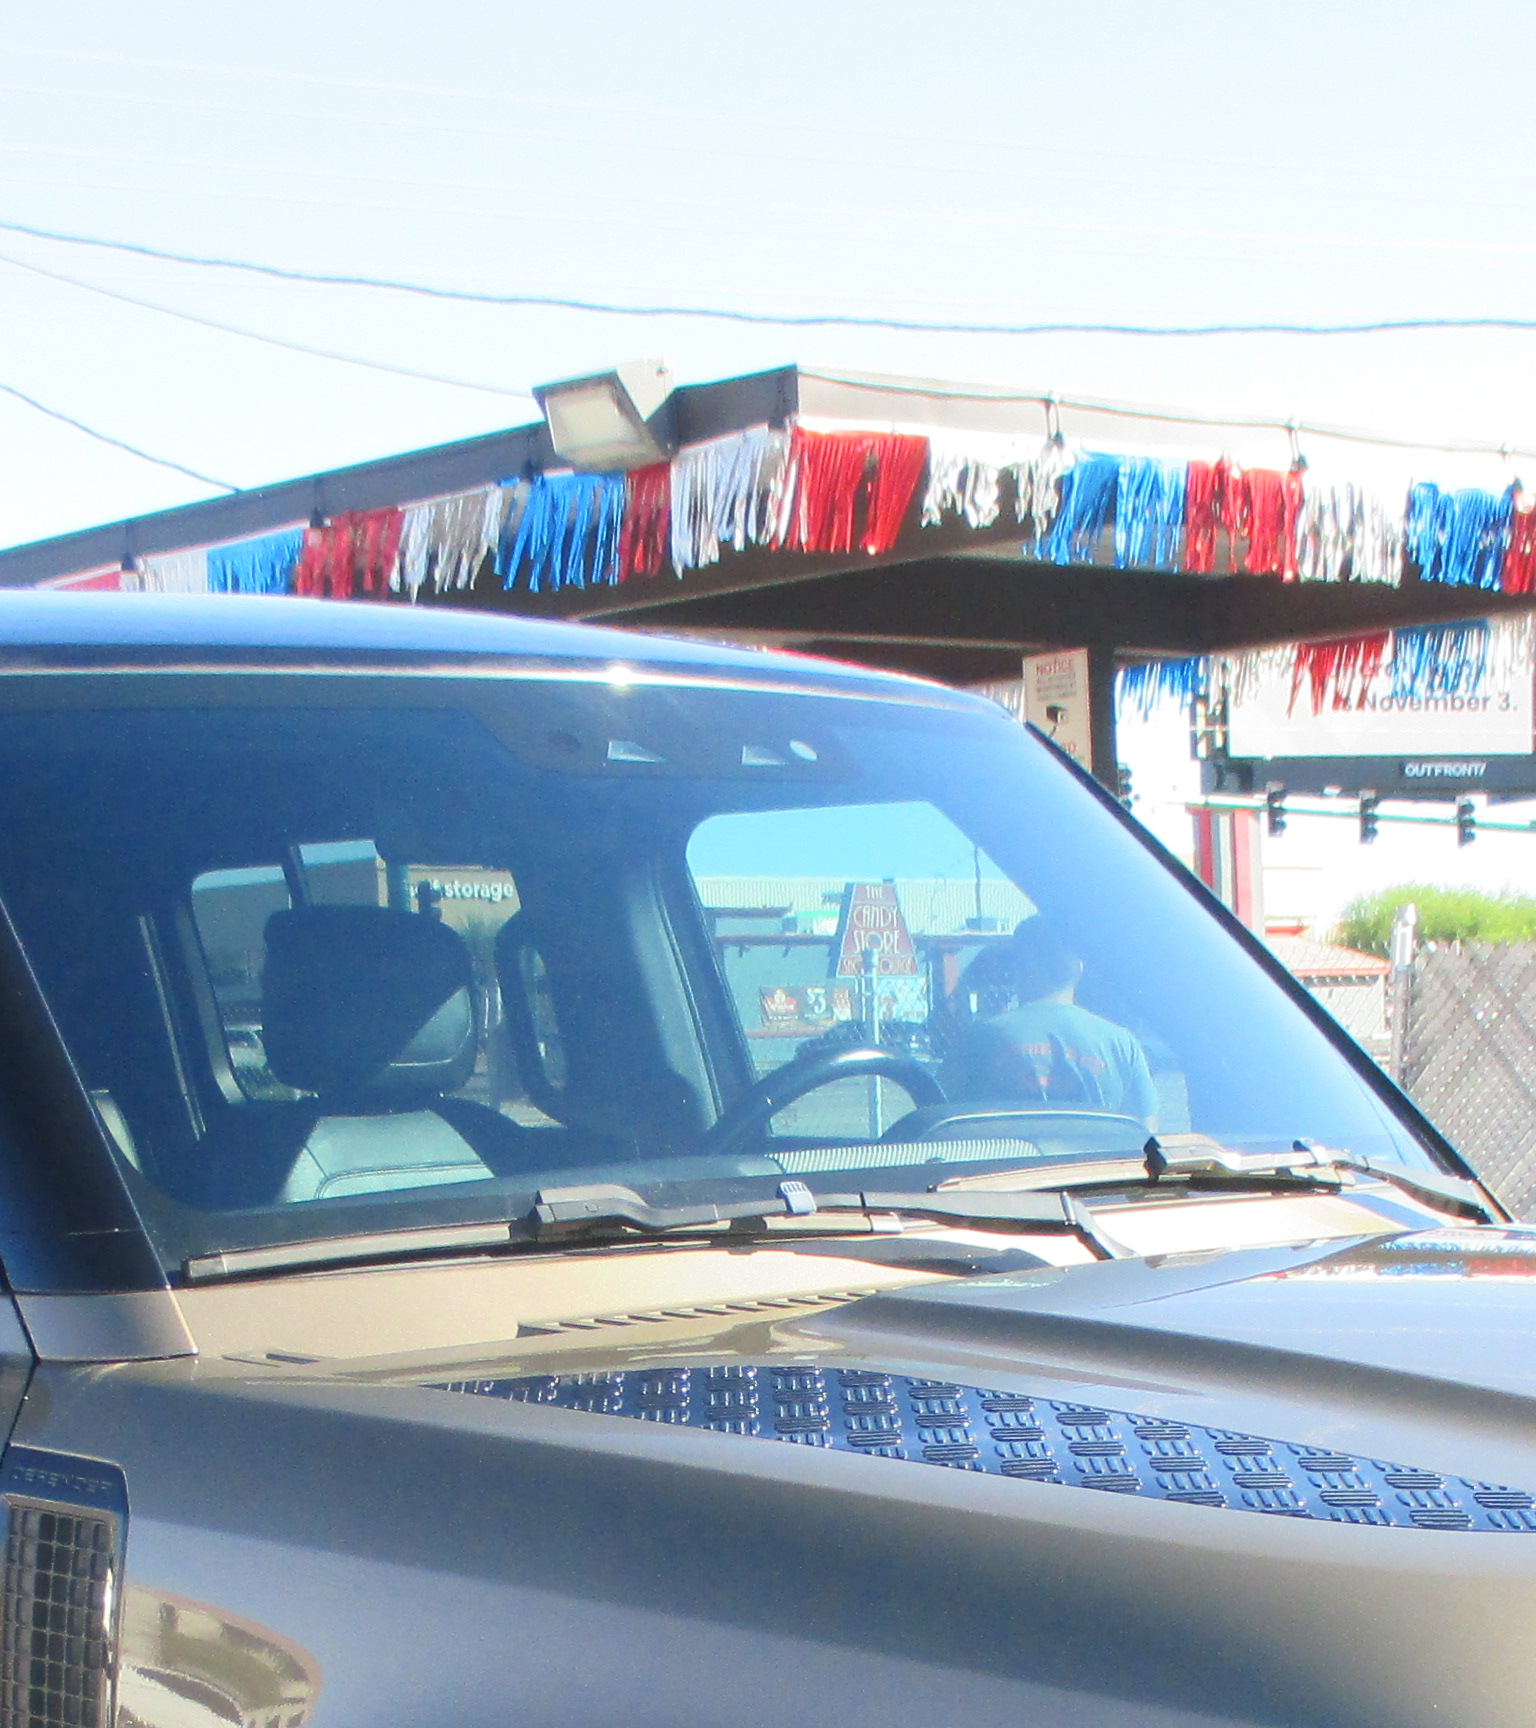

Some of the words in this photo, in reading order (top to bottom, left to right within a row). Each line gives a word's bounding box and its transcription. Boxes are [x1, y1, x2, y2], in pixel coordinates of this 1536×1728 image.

[1362, 692, 1492, 712] November
[1497, 692, 1518, 712] 3.
[444, 880, 514, 902] storage
[853, 905, 898, 929] CANDY
[853, 930, 901, 955] STORE
